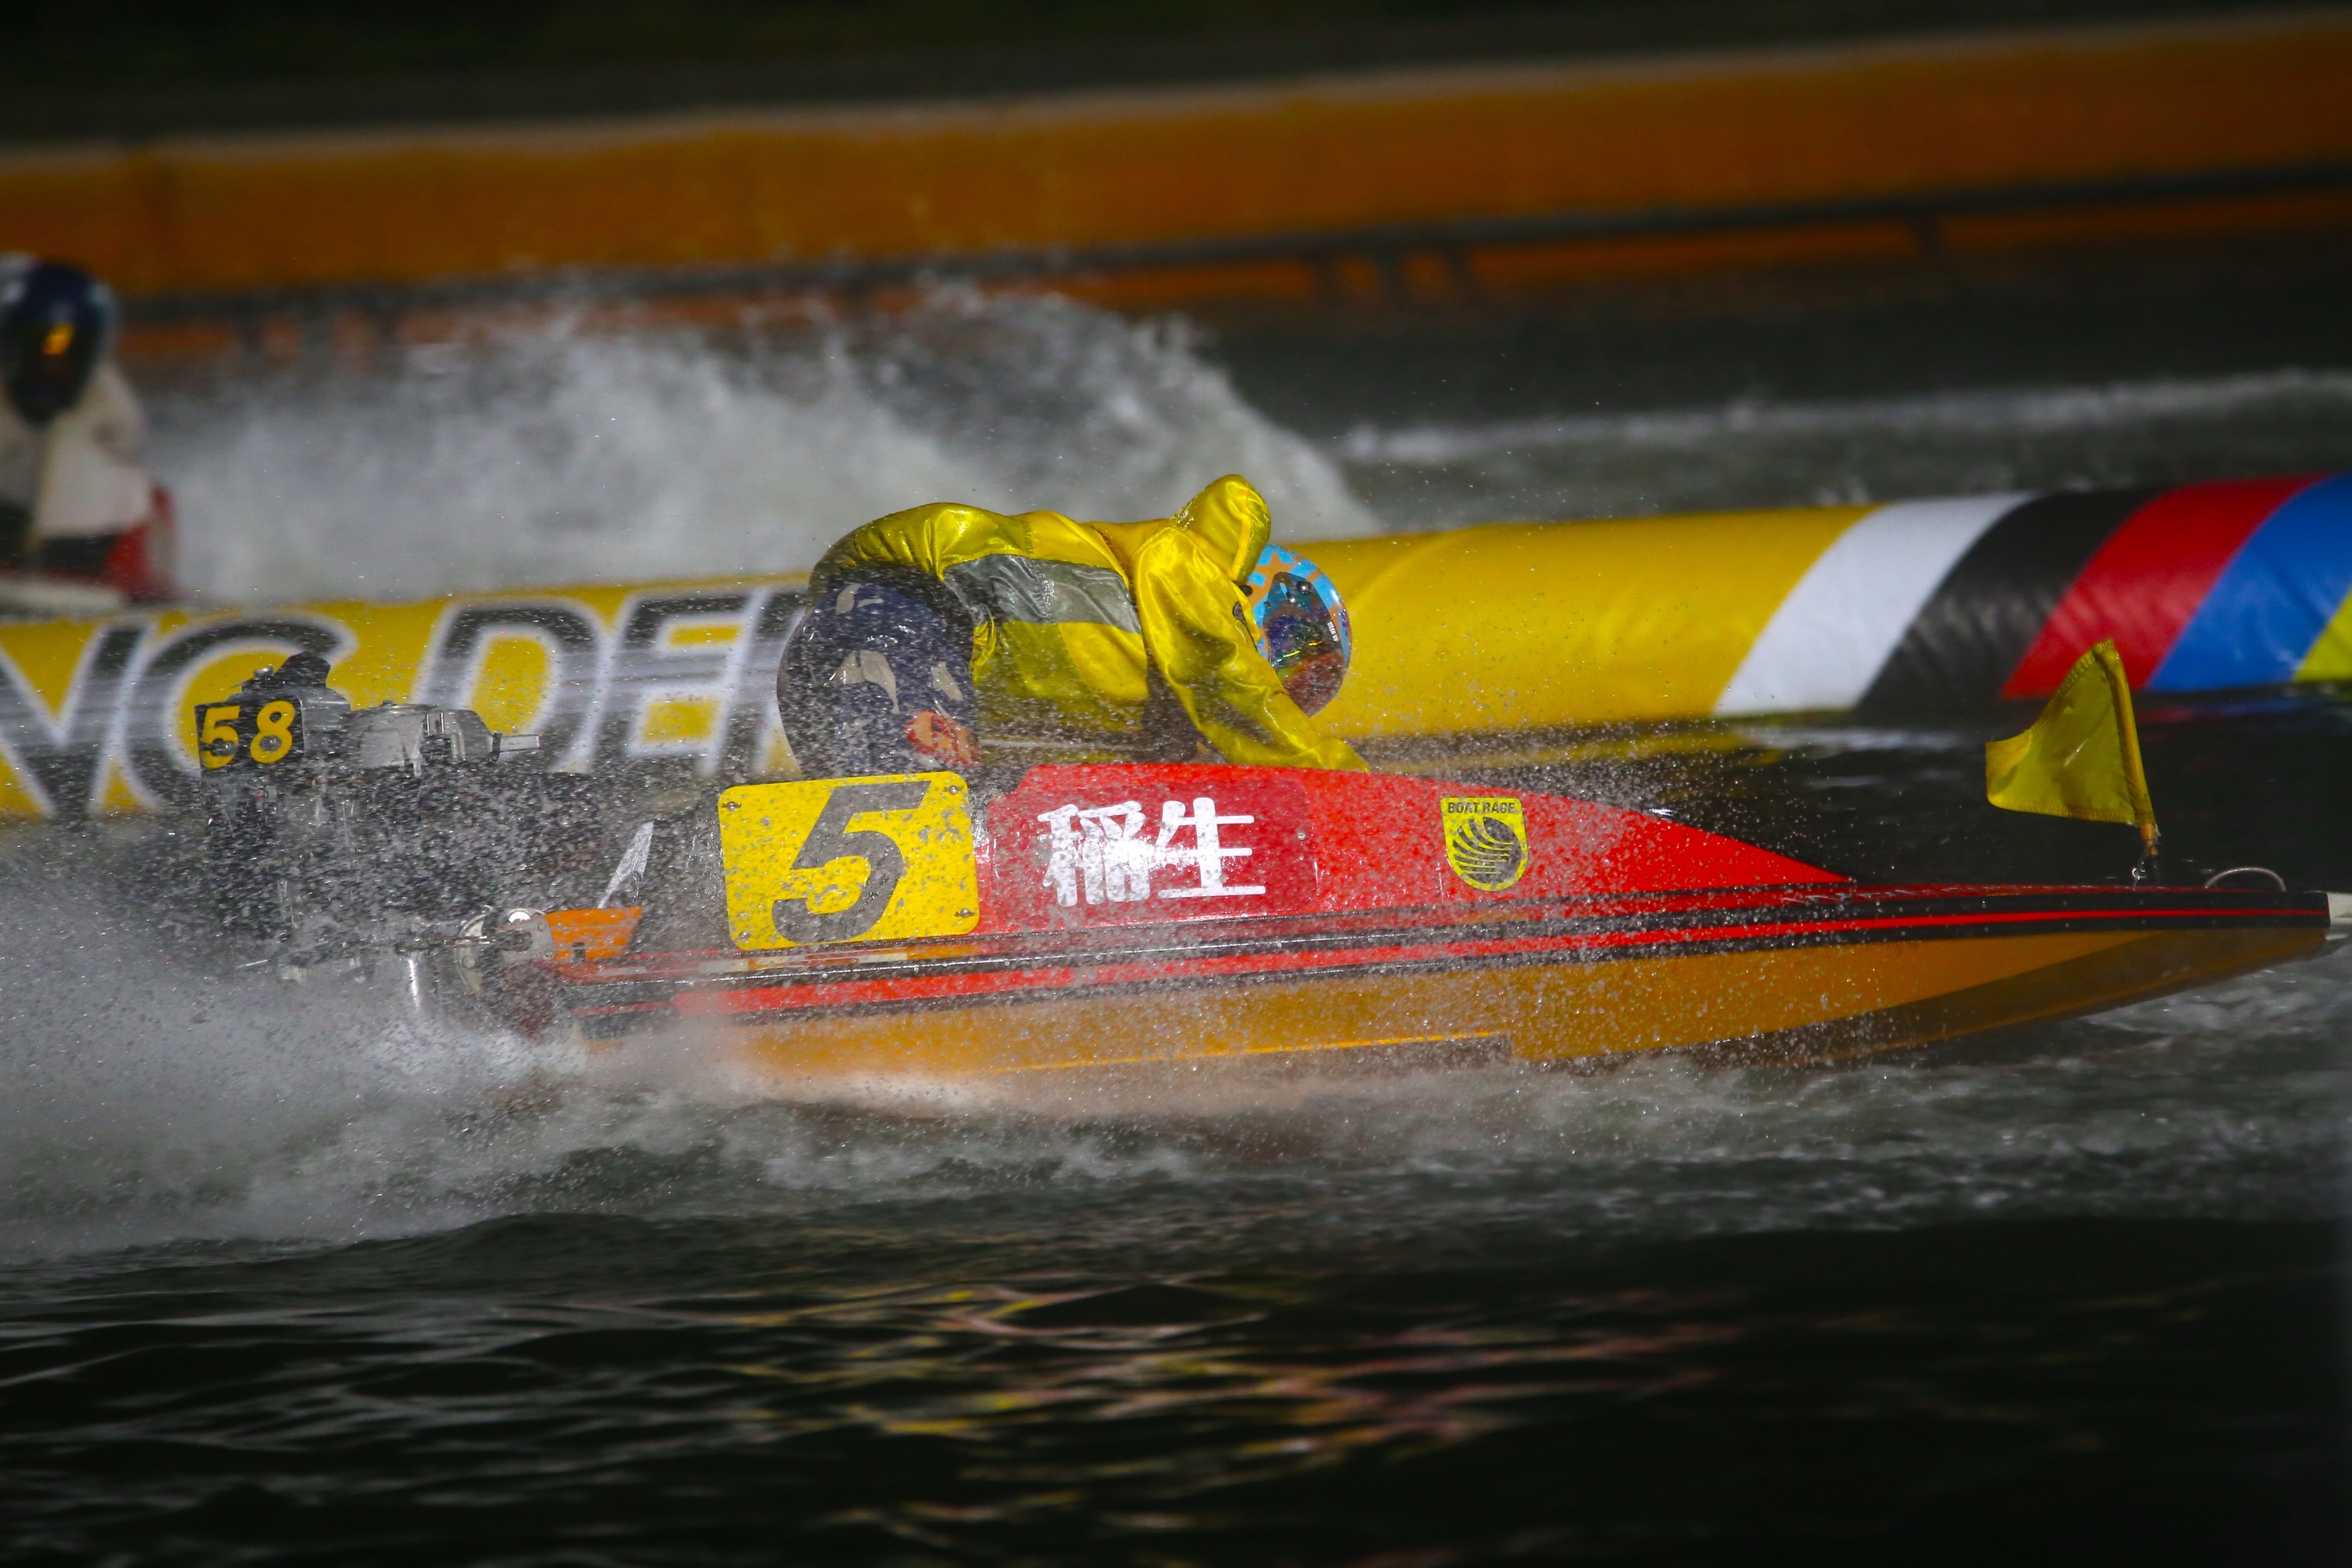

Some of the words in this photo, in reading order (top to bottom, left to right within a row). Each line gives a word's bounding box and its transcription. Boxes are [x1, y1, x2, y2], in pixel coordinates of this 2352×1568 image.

[200, 700, 296, 770] 58
[1036, 796, 1266, 906] 稲生
[1447, 801, 1480, 814] BOAT
[1482, 801, 1515, 814] RACE
[771, 780, 932, 944] 5
